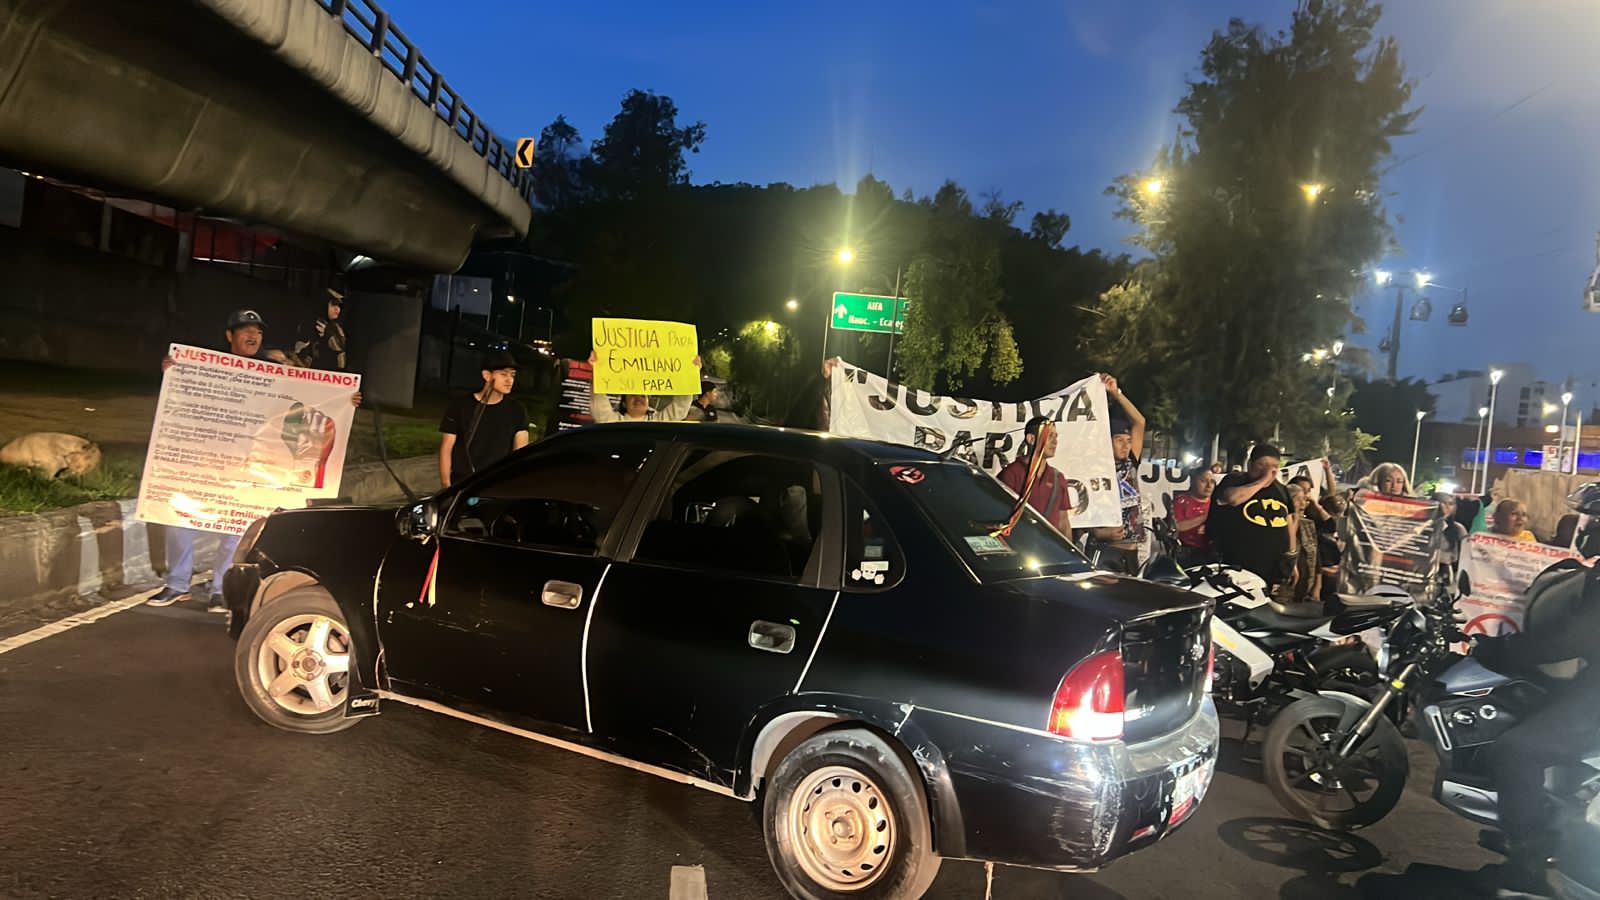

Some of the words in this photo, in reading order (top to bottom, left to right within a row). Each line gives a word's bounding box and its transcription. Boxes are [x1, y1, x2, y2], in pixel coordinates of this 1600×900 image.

[595, 320, 660, 348] JUSTICIA
[247, 361, 285, 376] PARA
[287, 368, 358, 387] EMILIANO!
[609, 348, 681, 374] EMILIANO
